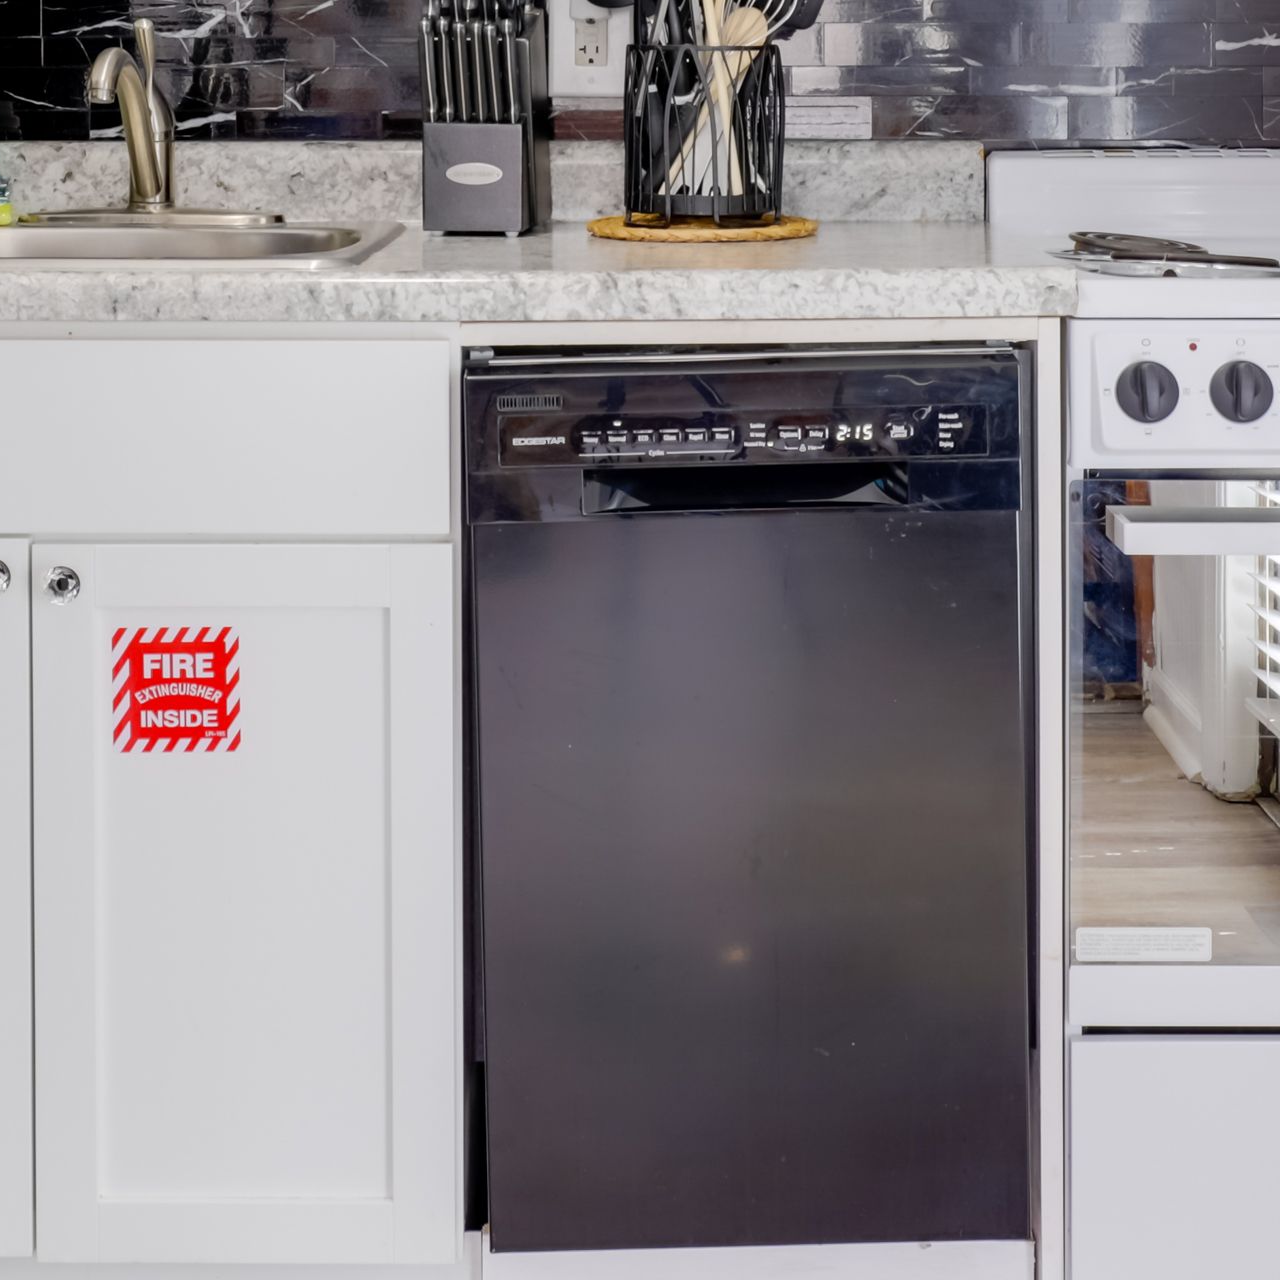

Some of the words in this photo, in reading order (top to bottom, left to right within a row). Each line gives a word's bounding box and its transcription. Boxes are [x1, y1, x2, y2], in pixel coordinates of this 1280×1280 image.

[512, 436, 565, 446] EDGESTAR
[836, 424, 873, 441] 2:15
[142, 652, 214, 679] FIRE
[133, 682, 224, 705] EXTINGUISHER
[139, 708, 219, 728] INSIDE
